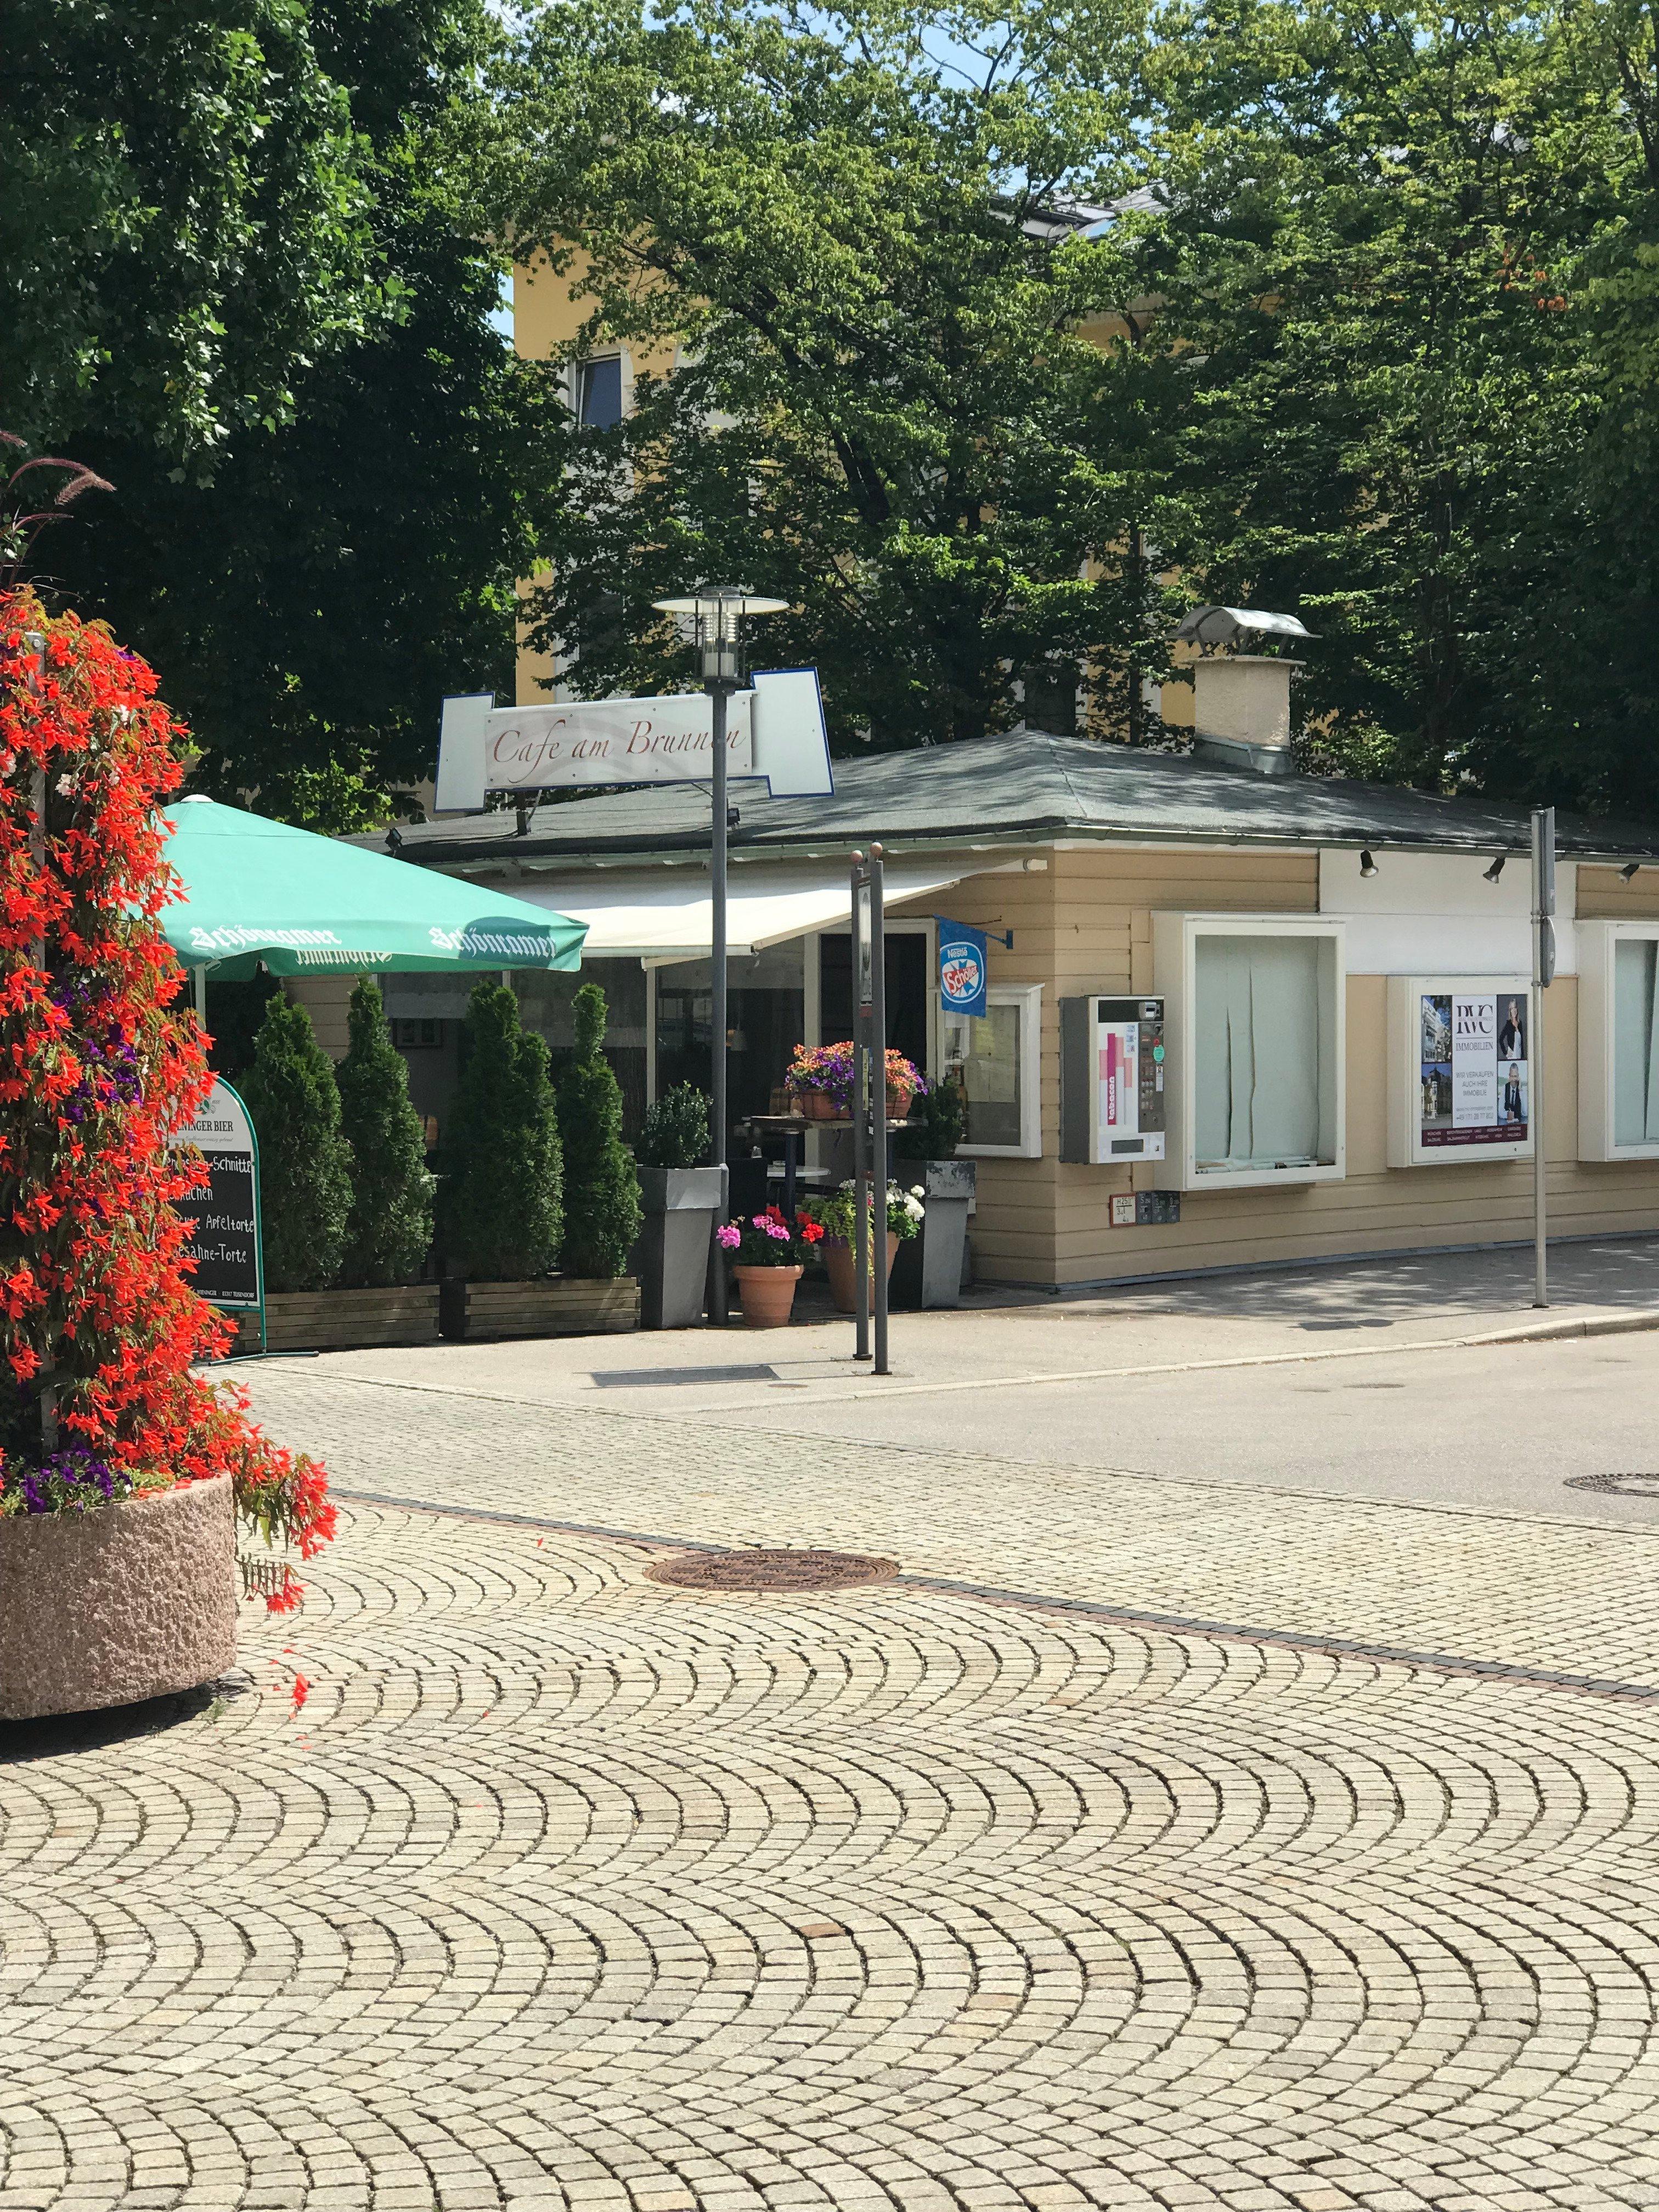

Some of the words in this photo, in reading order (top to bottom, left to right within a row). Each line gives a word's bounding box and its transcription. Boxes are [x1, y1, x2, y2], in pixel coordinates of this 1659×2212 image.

[493, 719, 566, 783] Cafe
[572, 737, 614, 759] am
[626, 720, 747, 755] Brunnn
[1455, 1042, 1493, 1052] IMMOBILIEN
[213, 1121, 234, 1132] BIER
